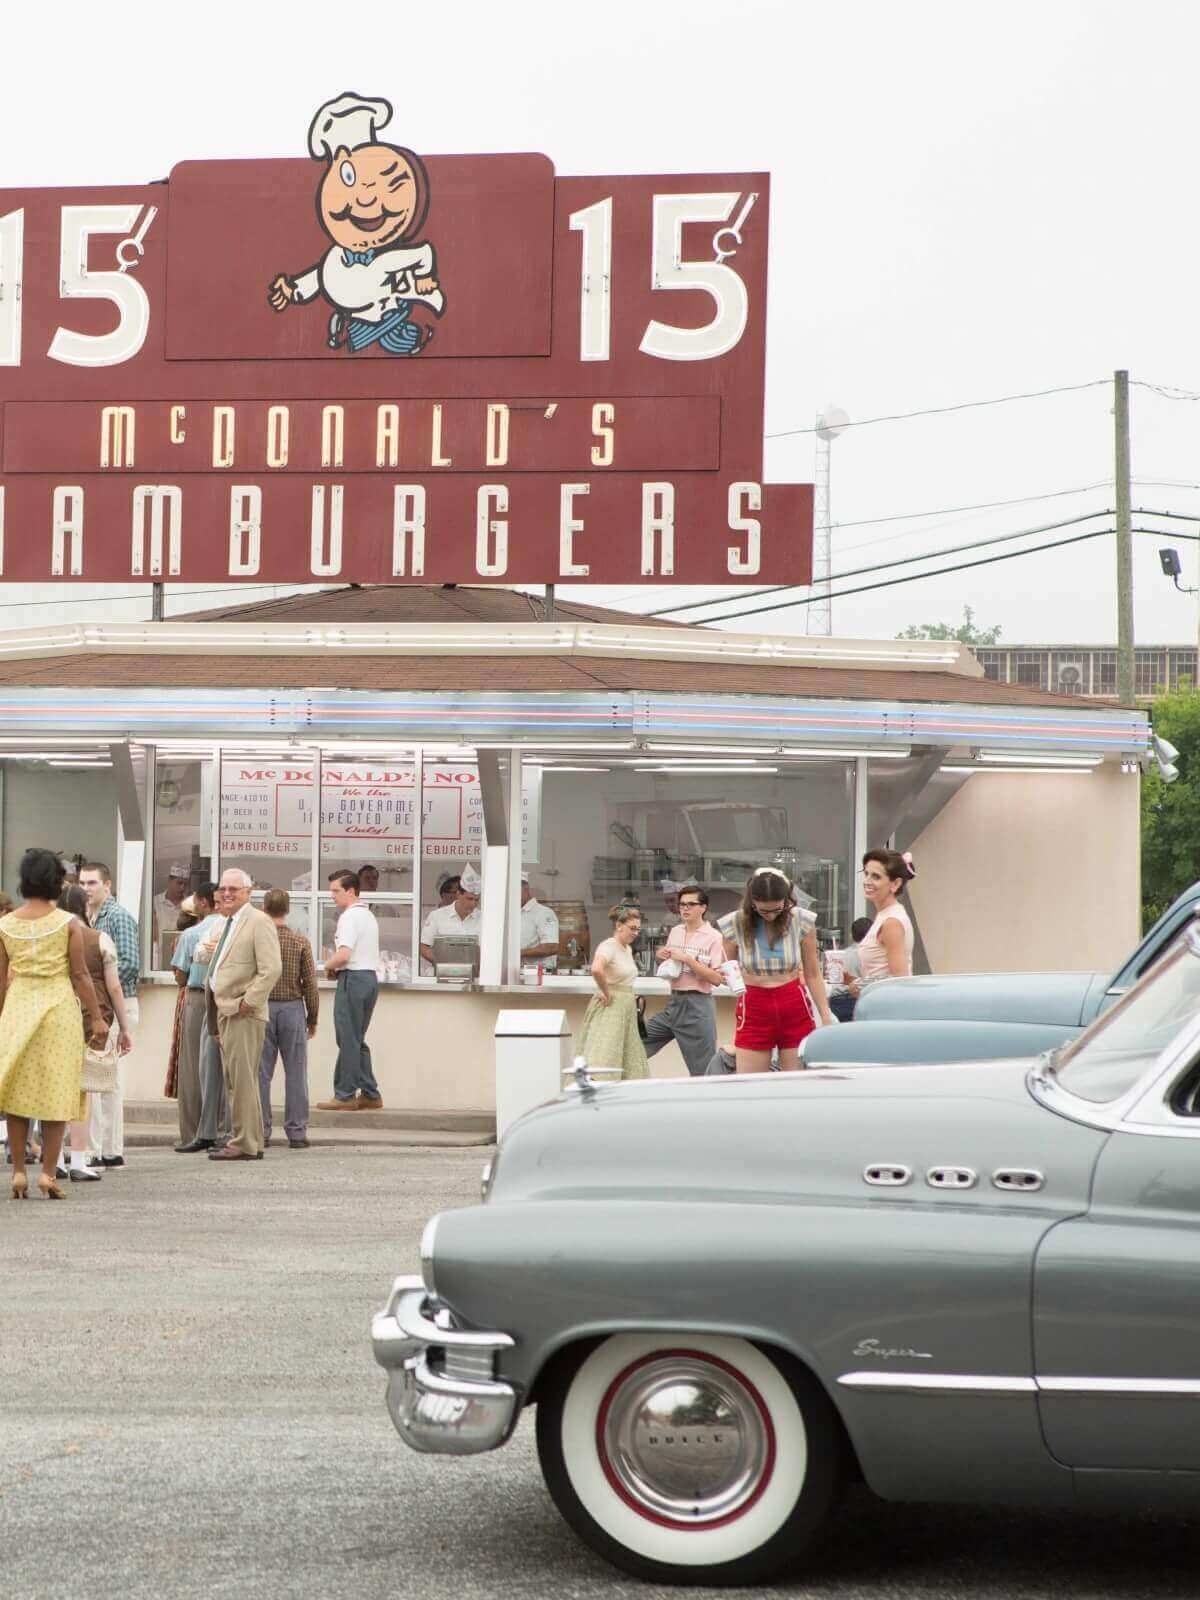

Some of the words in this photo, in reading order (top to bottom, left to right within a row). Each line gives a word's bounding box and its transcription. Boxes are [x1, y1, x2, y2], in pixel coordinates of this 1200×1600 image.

[340, 799, 433, 812] GOVERNMET
[395, 813, 428, 825] BEF
[222, 841, 299, 853] HAMBURGERS
[853, 1338, 933, 1359] Super
